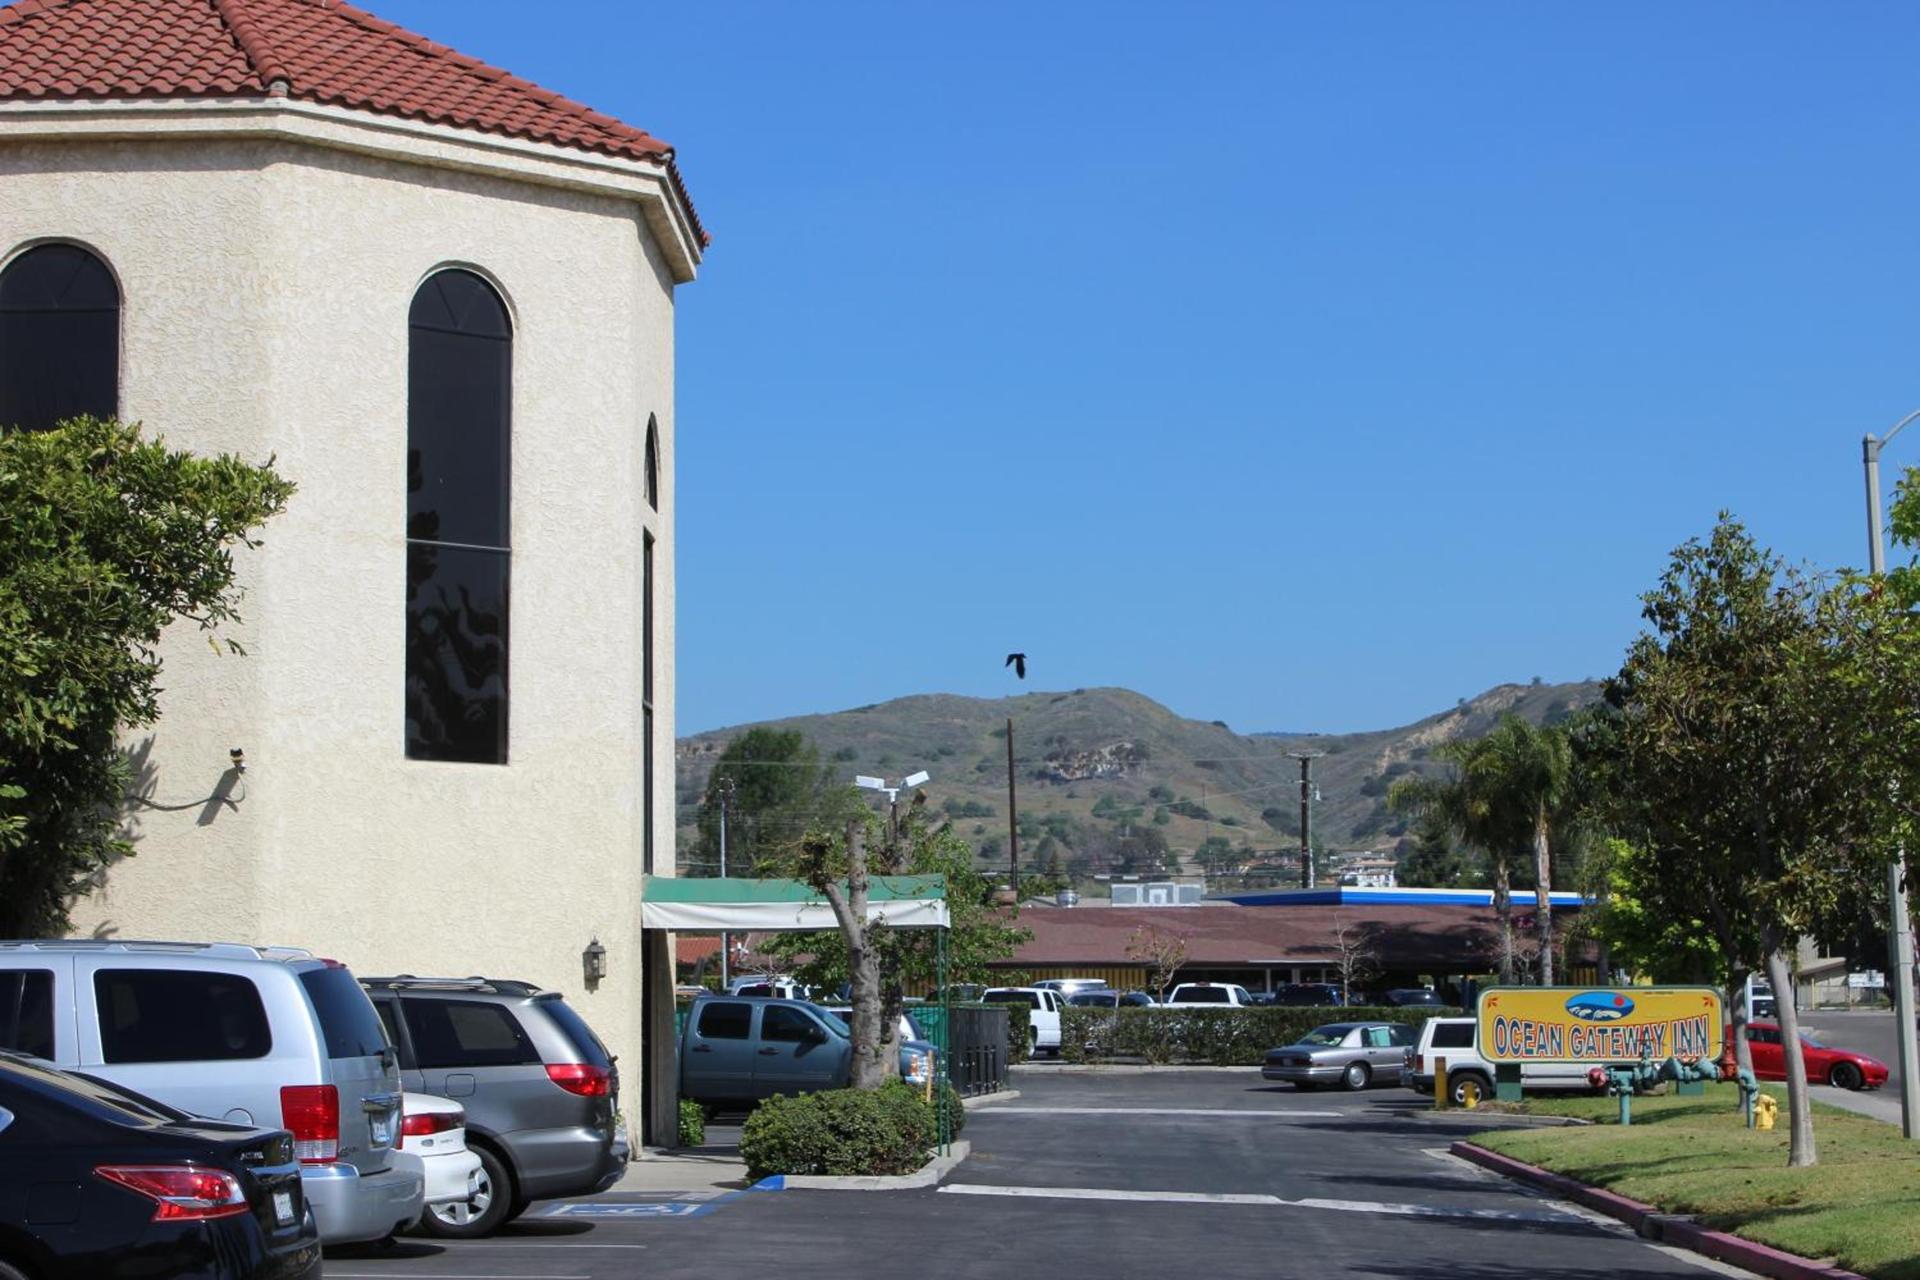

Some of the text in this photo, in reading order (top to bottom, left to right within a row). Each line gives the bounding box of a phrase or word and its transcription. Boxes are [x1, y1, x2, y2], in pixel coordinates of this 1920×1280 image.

[1494, 1014, 1710, 1058] OCEAN GATEWAY INN
